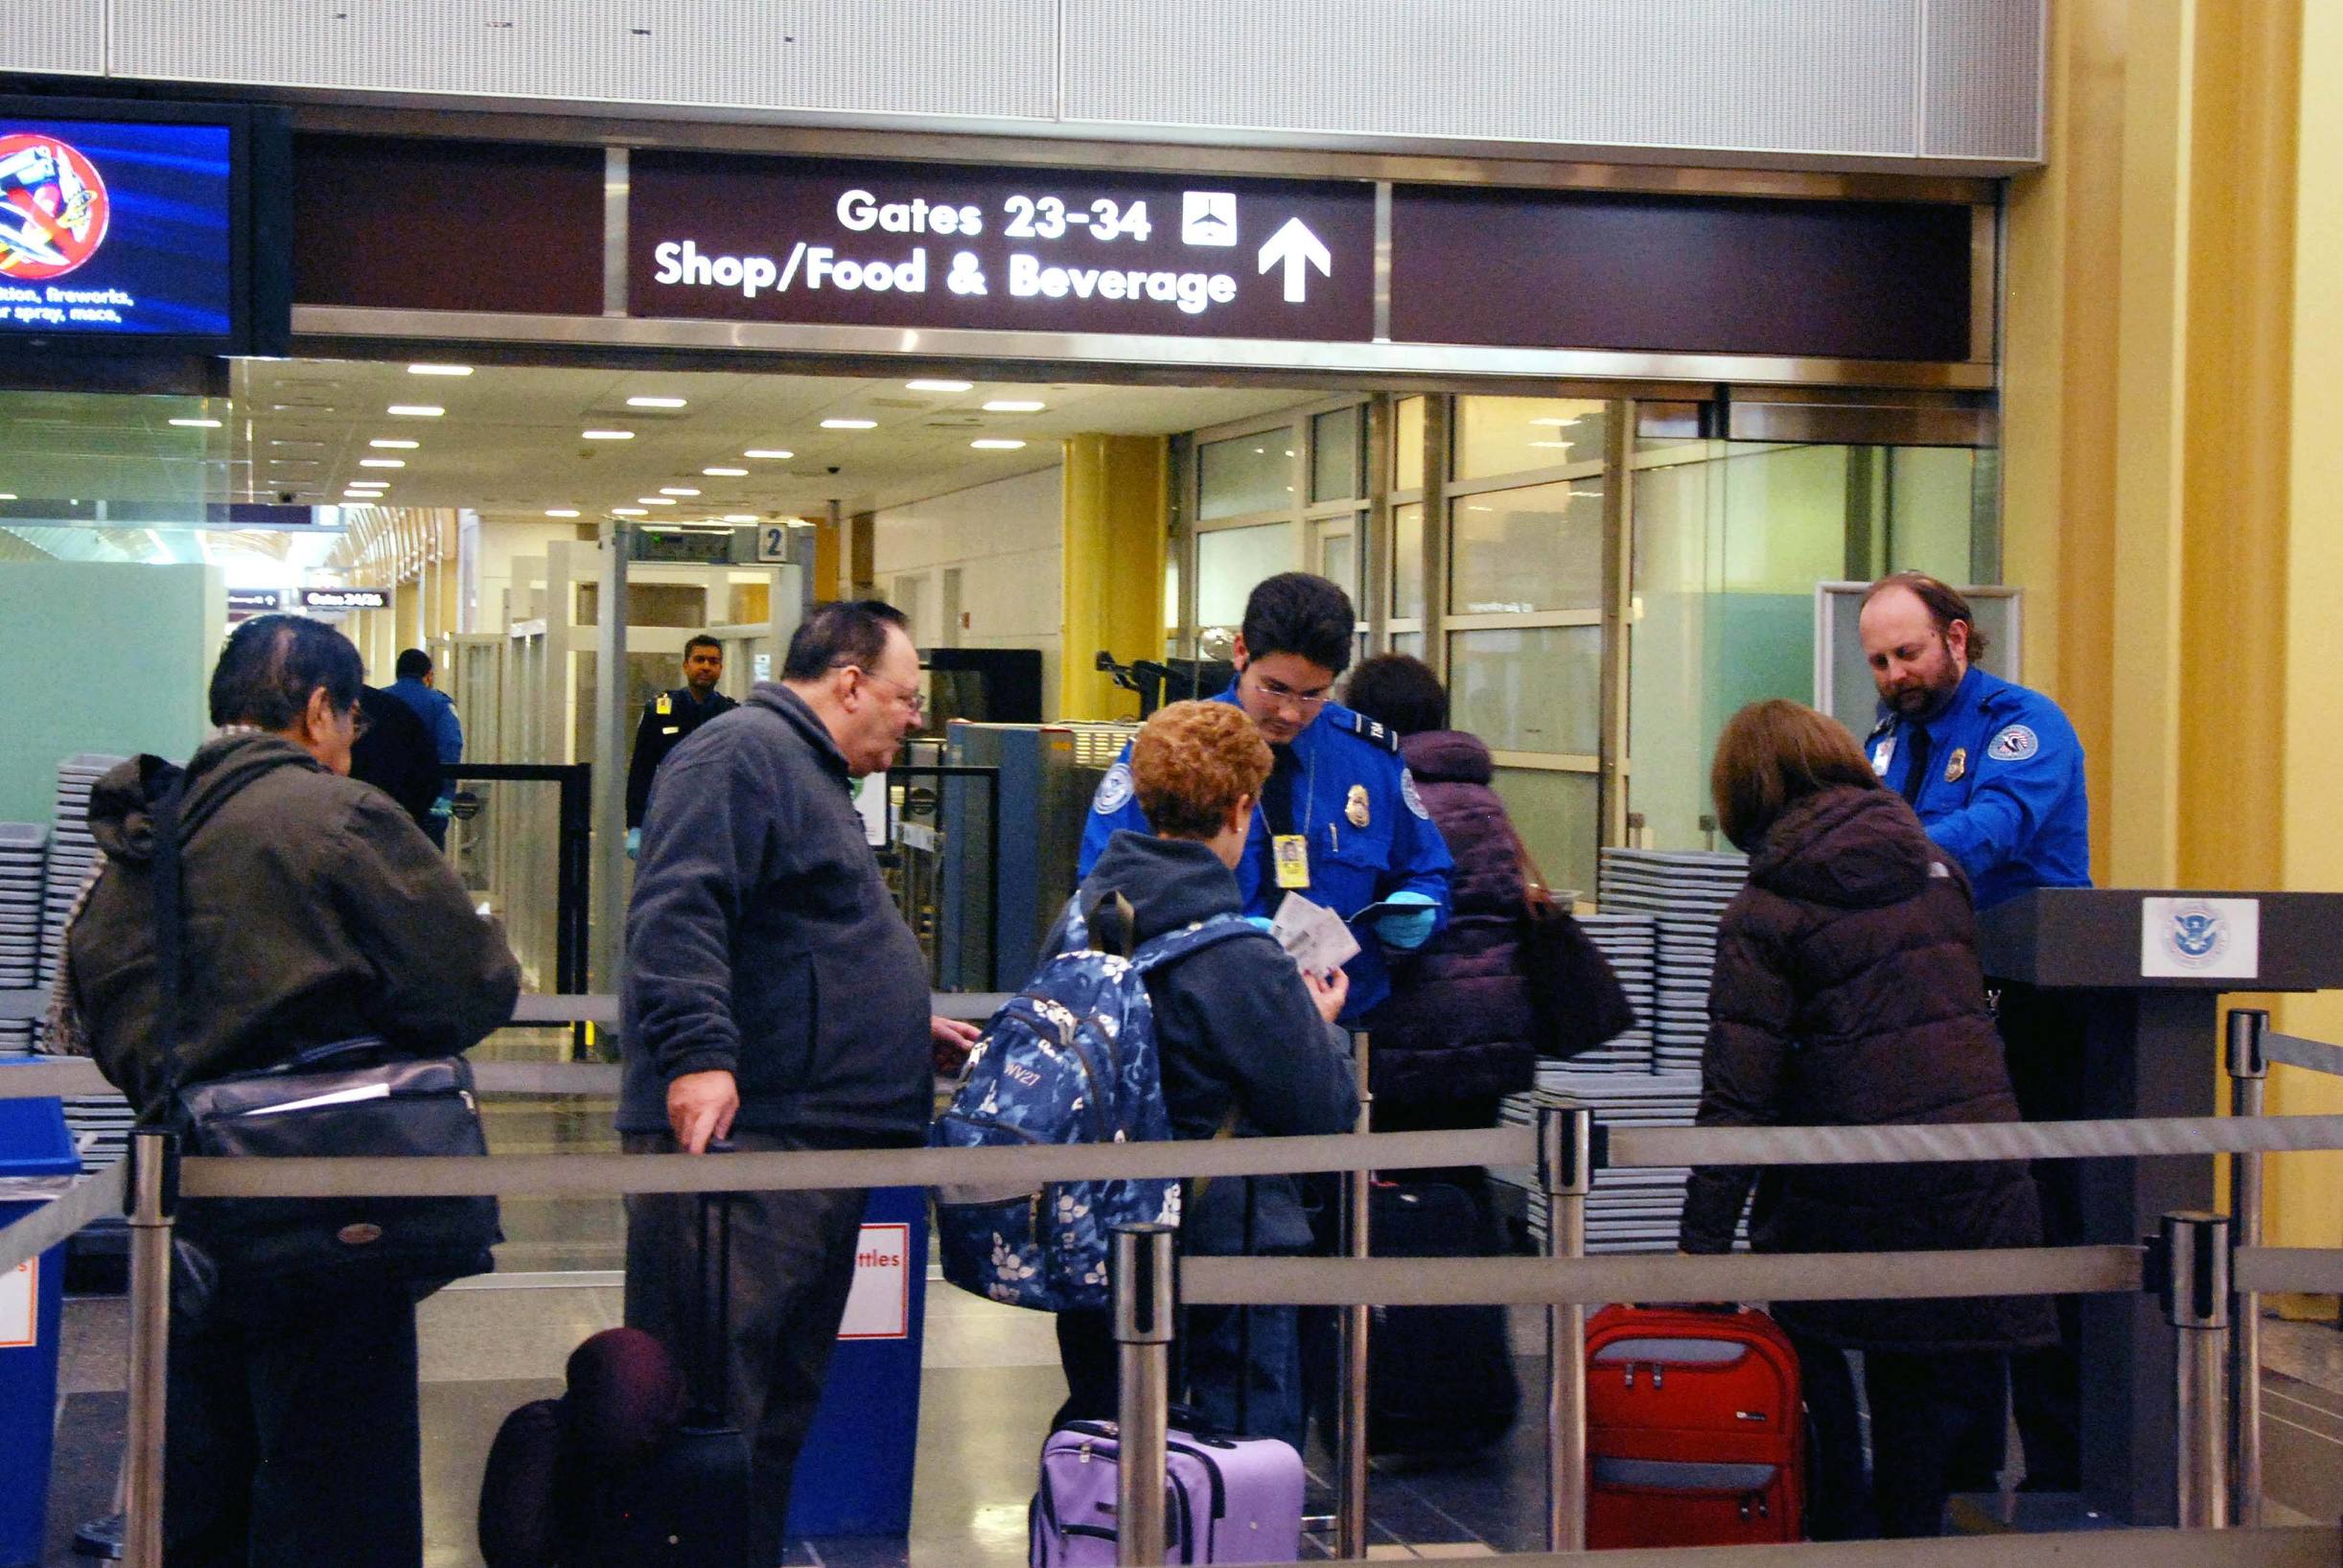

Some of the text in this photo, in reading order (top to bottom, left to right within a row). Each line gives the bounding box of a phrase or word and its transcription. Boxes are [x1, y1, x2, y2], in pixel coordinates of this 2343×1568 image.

[837, 190, 1151, 241] Gates 23-34
[655, 241, 1237, 313] Shop/Food & Beverage
[768, 528, 781, 556] 2
